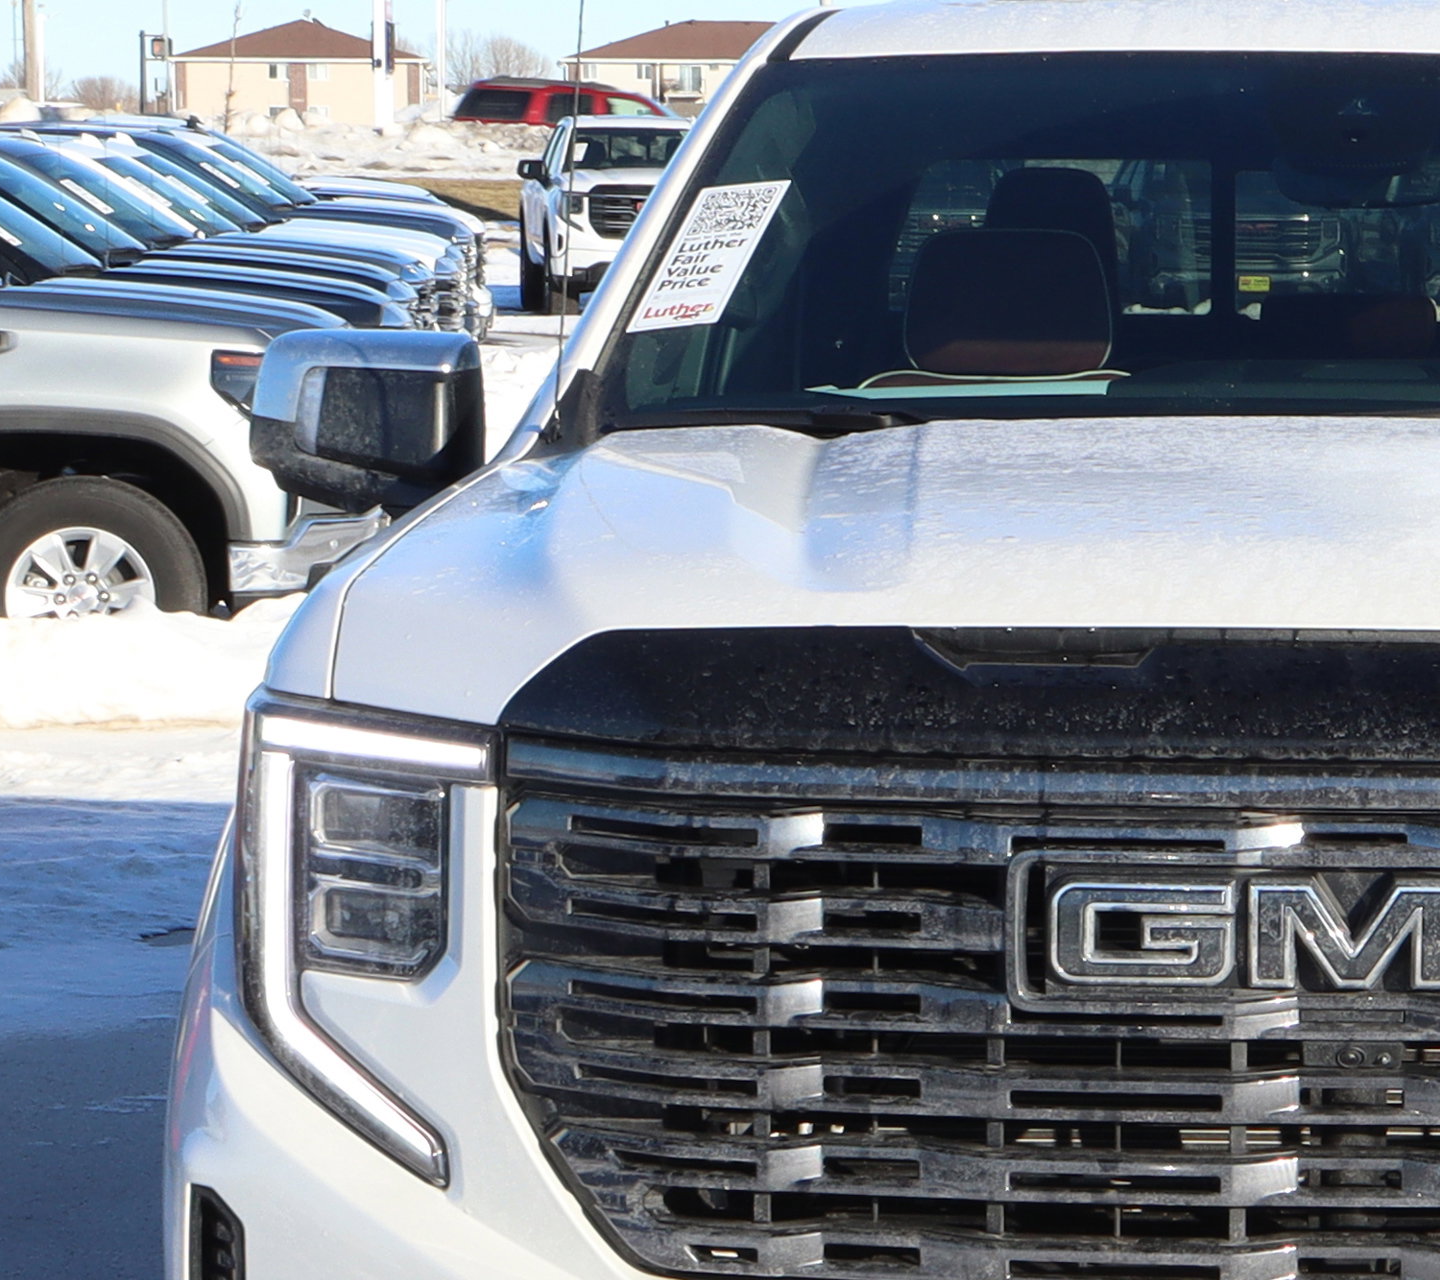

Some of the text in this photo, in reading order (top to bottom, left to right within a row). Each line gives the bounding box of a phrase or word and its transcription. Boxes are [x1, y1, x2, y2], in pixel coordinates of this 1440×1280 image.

[677, 235, 748, 254] Luther
[670, 252, 710, 266] Fair
[665, 262, 724, 278] Value
[657, 275, 711, 292] Price
[643, 301, 714, 320] Luther
